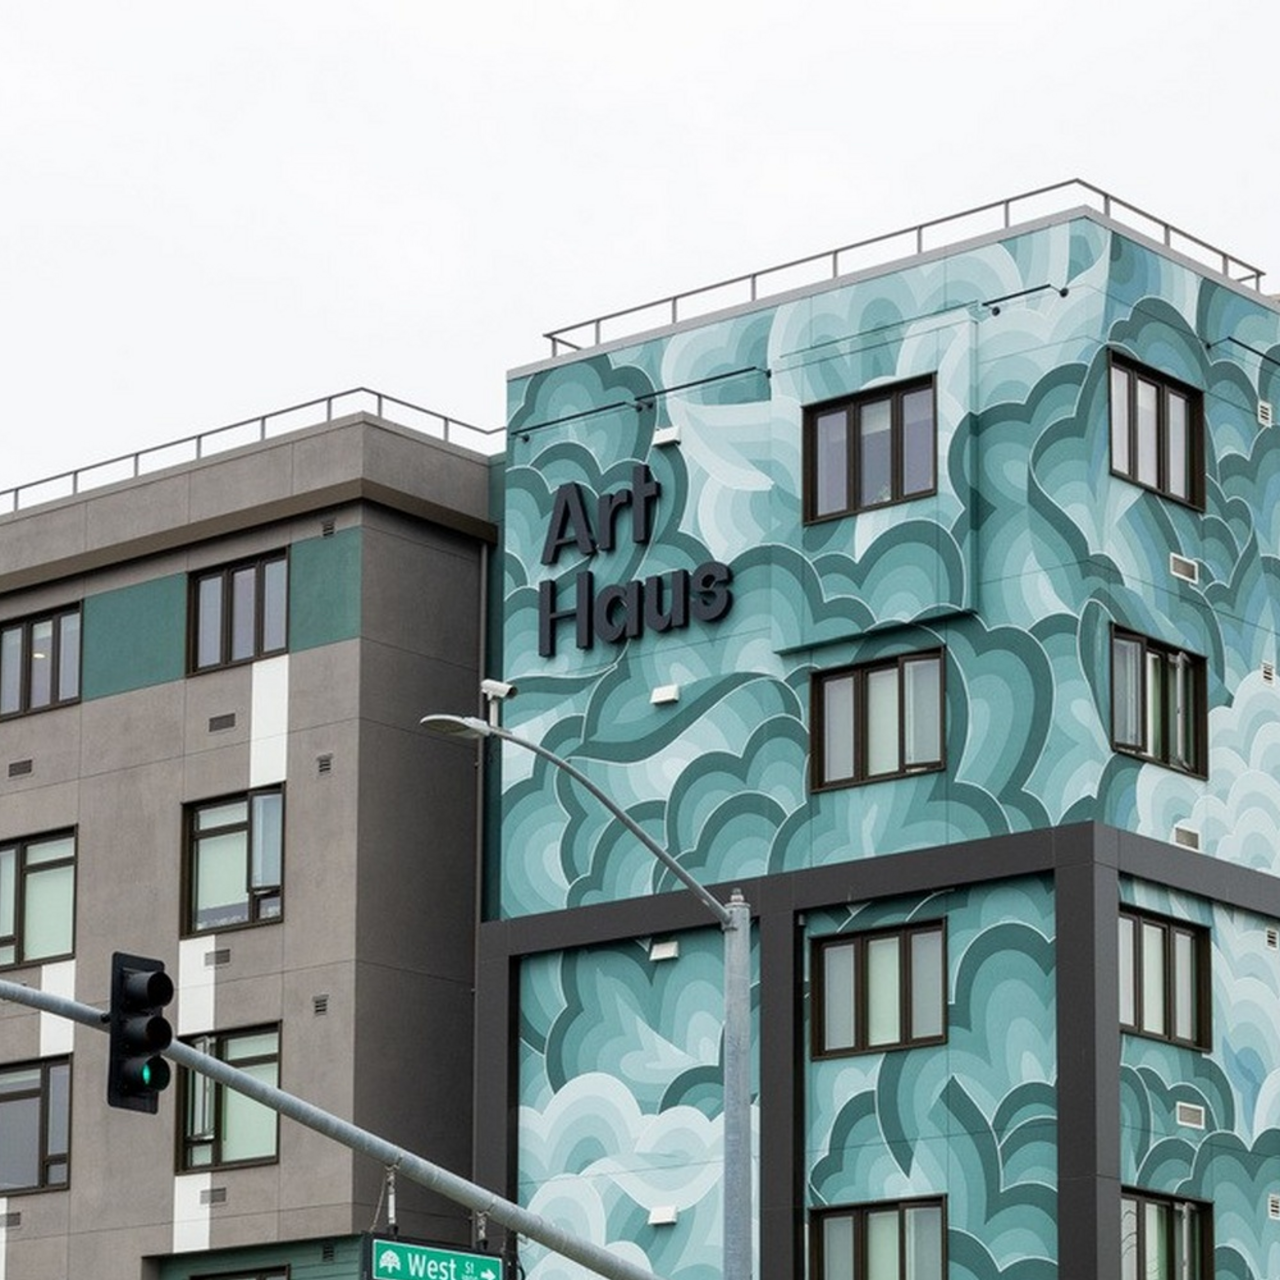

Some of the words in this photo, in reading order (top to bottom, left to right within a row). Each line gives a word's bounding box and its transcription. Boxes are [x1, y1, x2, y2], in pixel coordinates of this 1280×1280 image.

[541, 464, 661, 566] Art
[539, 561, 733, 658] Haus
[465, 1261, 475, 1274] St
